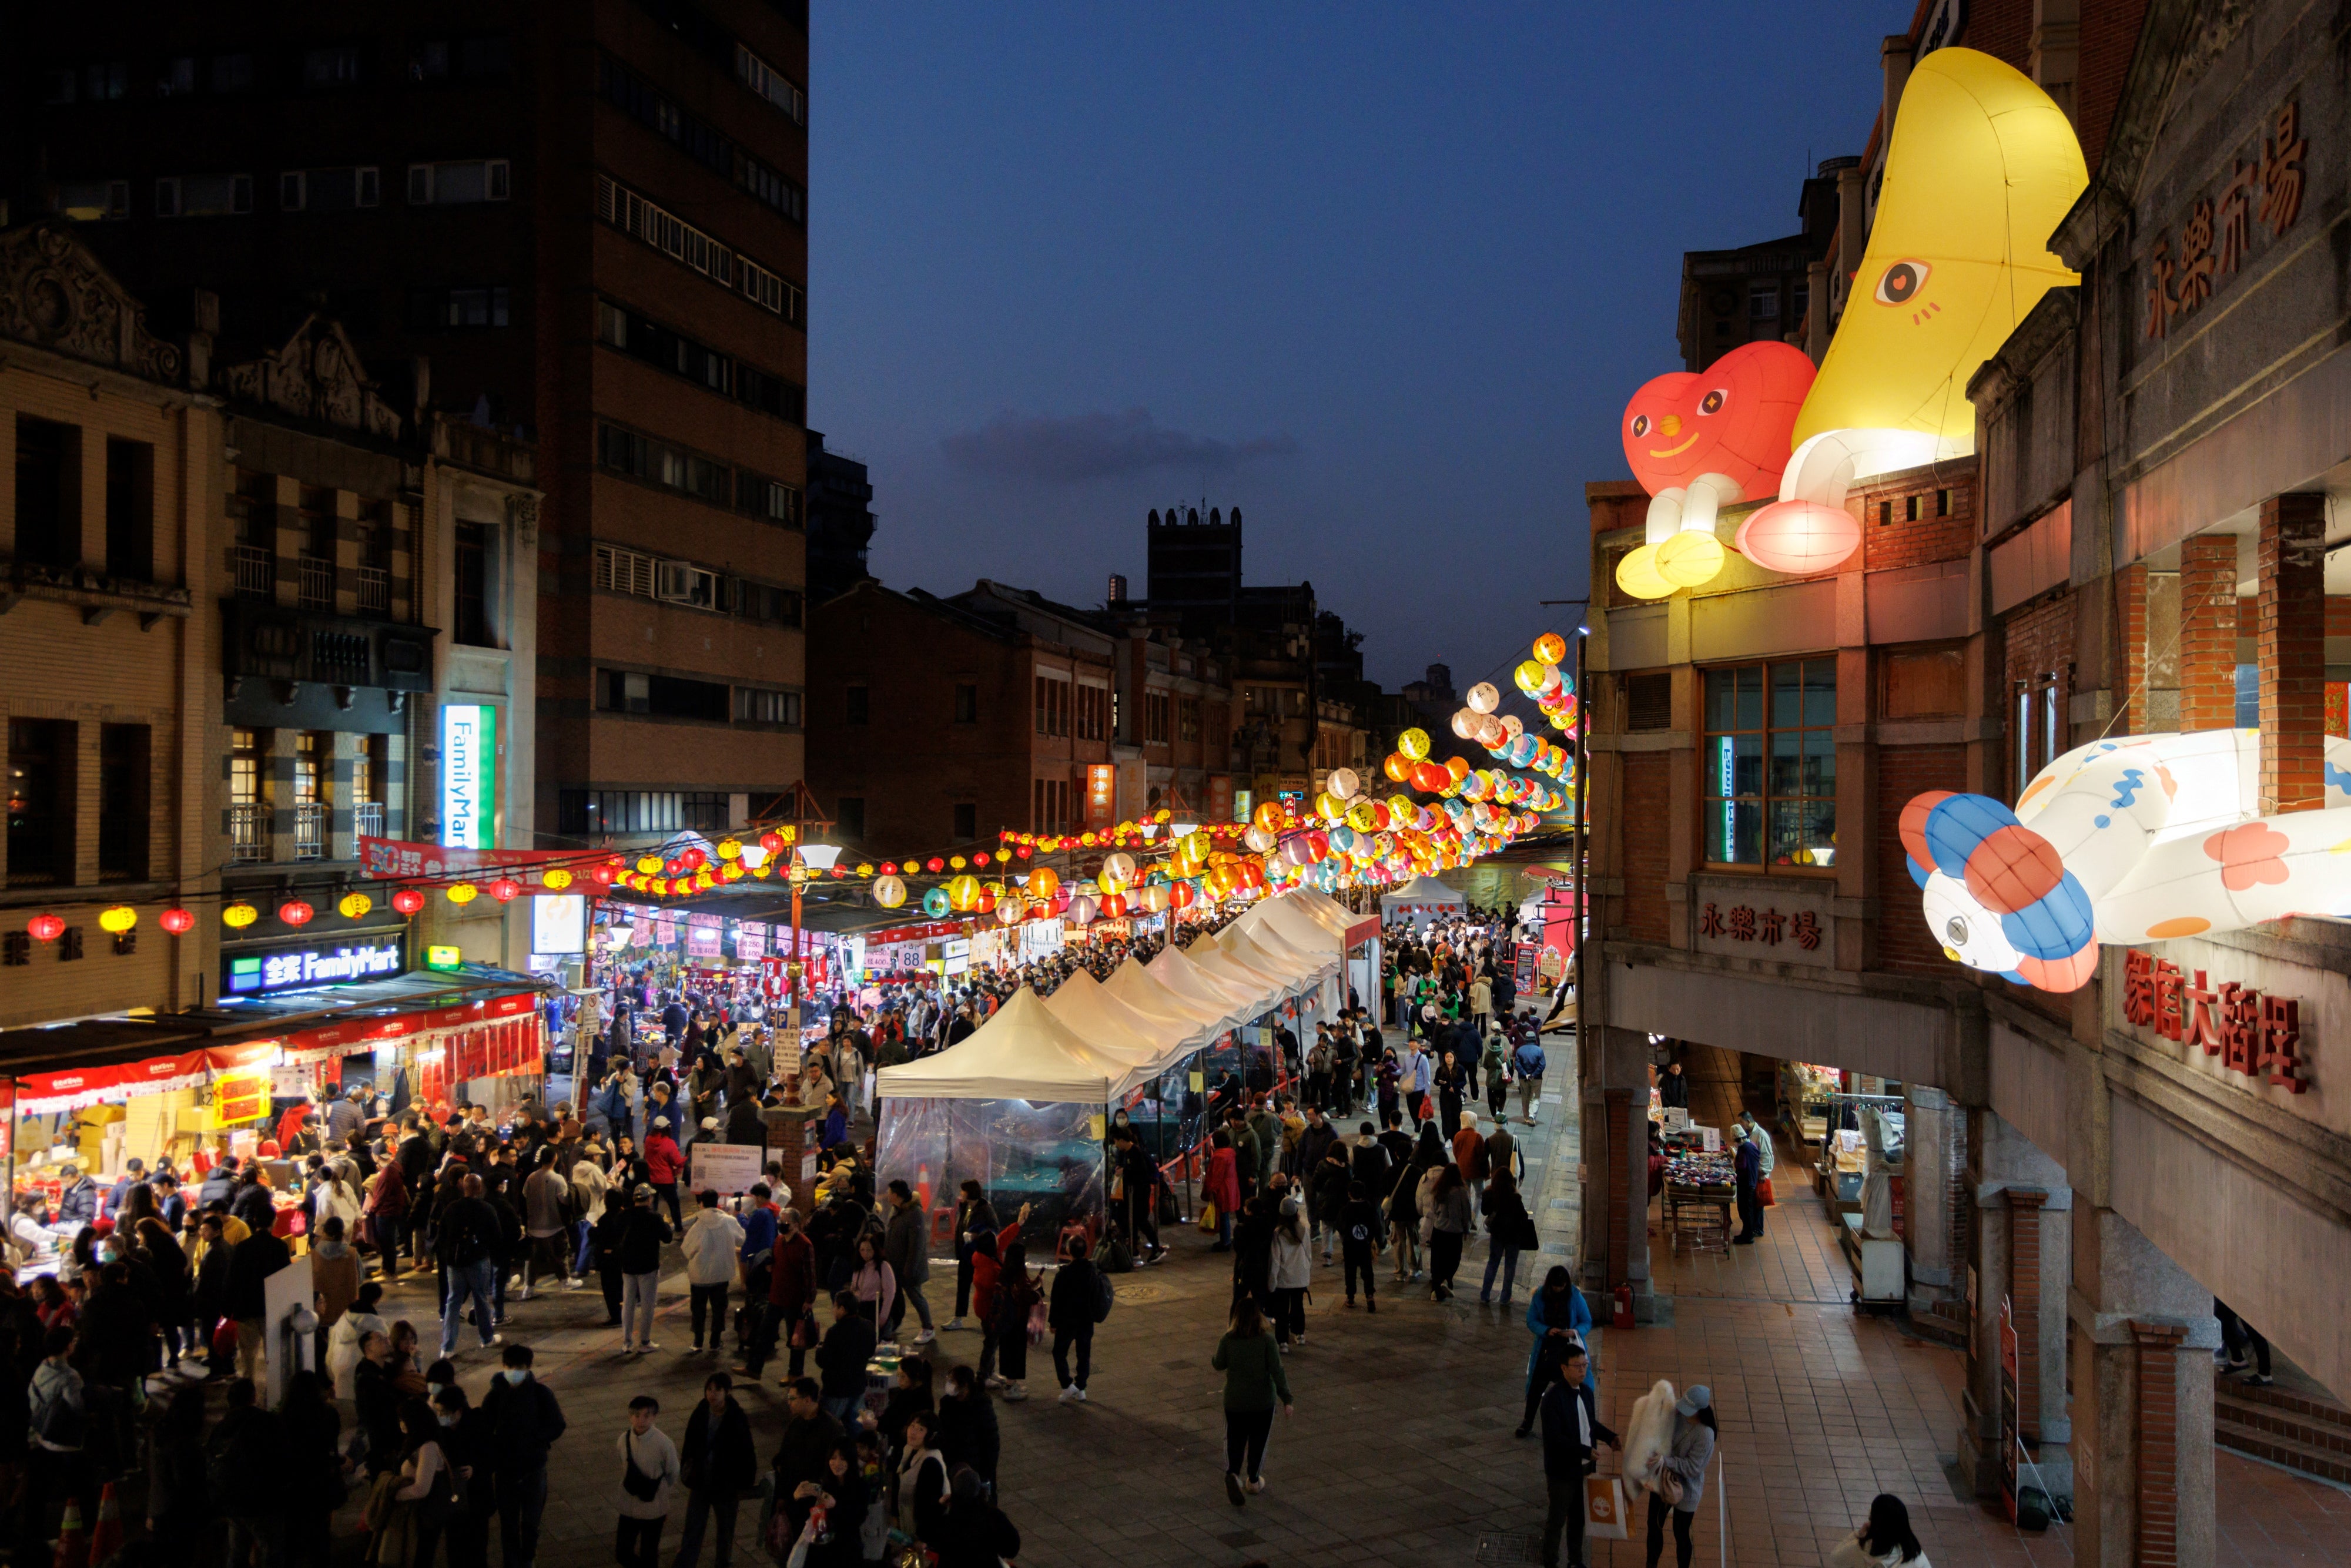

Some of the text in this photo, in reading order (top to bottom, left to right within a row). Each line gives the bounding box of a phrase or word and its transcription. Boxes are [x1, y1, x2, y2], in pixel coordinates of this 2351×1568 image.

[2146, 101, 2309, 340] 永樂市場
[1698, 902, 1822, 950] 永樂市場
[266, 945, 399, 985] 全家 FamilyMart
[778, 1013, 786, 1027] P
